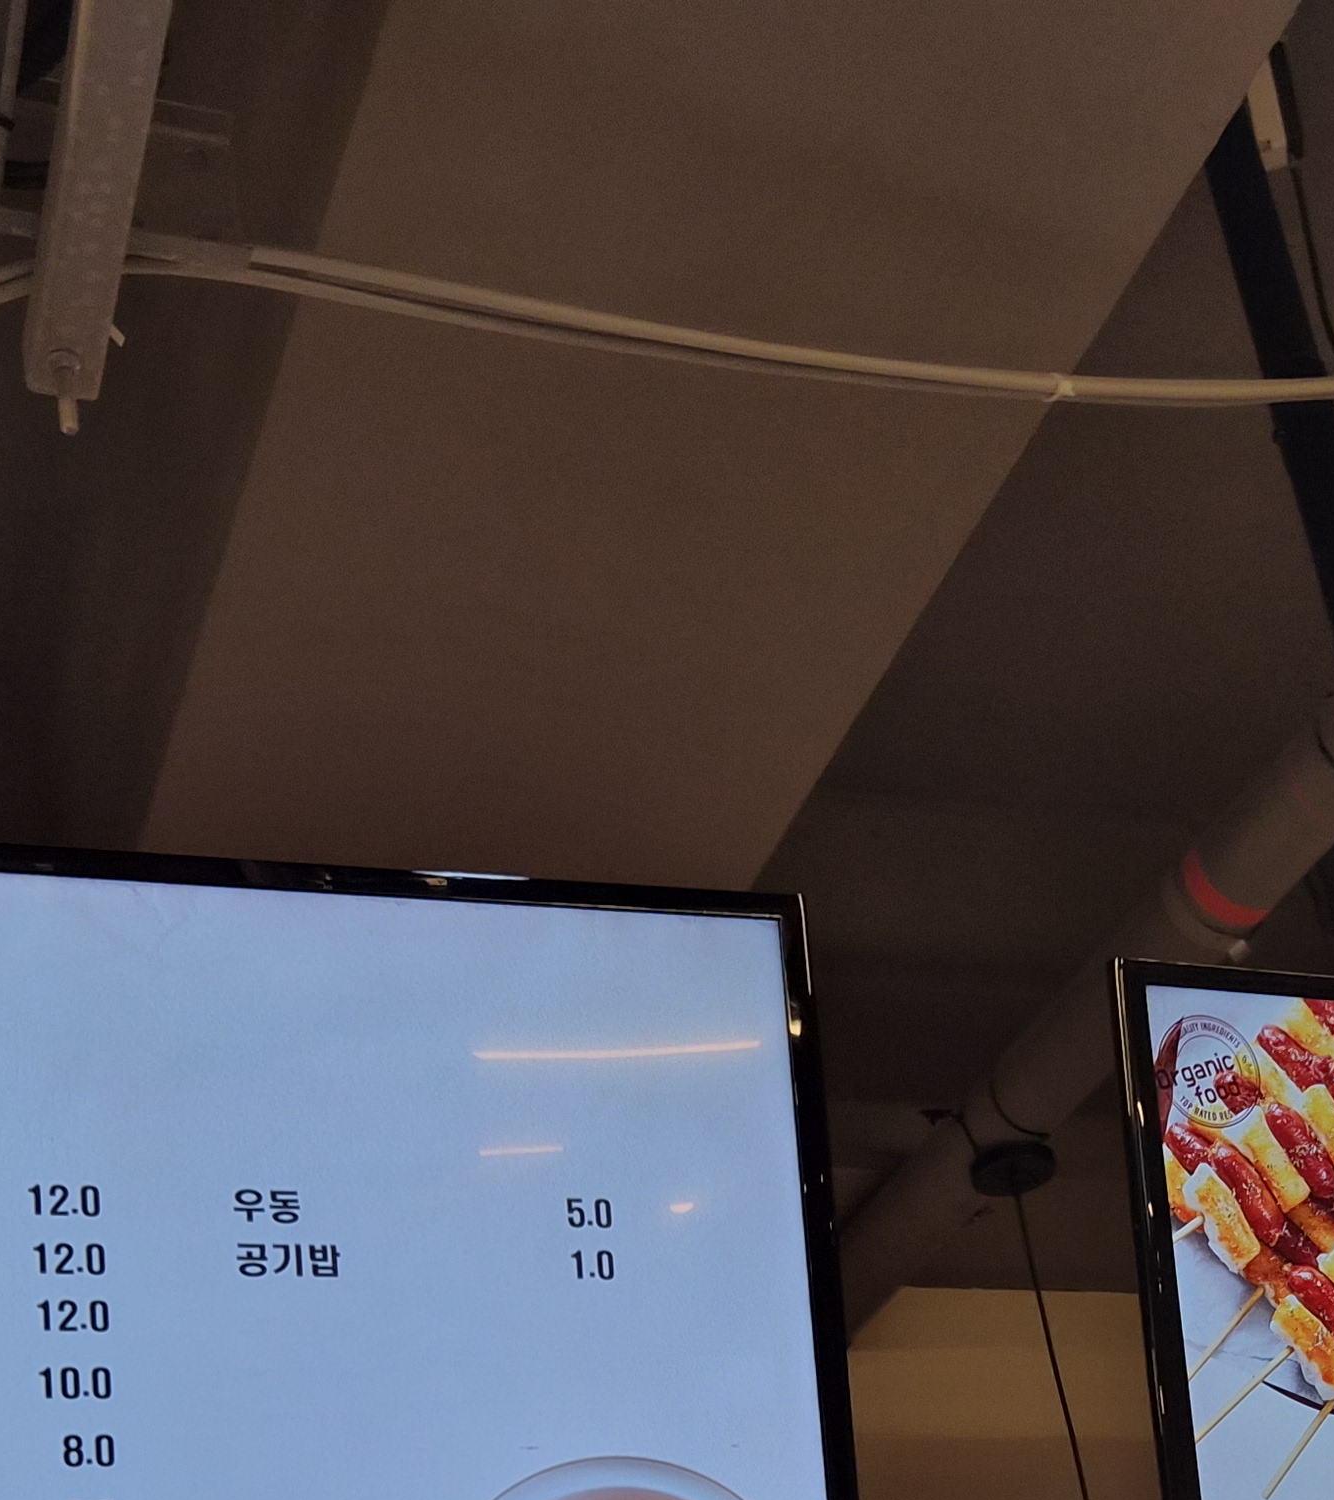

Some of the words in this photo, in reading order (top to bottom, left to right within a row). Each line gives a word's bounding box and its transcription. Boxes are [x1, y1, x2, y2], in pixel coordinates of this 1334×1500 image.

[1200, 1022, 1242, 1049] INGREDIENTS
[1178, 1095, 1194, 1110] TOP
[1194, 1075, 1242, 1107] food
[29, 1185, 100, 1216] 12.0
[234, 1189, 299, 1223] 우동
[567, 1199, 611, 1228] 5.0
[34, 1243, 105, 1275] 12.0
[237, 1244, 340, 1277] 공기밥
[572, 1251, 614, 1280] 1.0
[38, 1300, 109, 1332] 12.0
[40, 1367, 111, 1399] 10.0
[64, 1435, 114, 1467] 8.0
